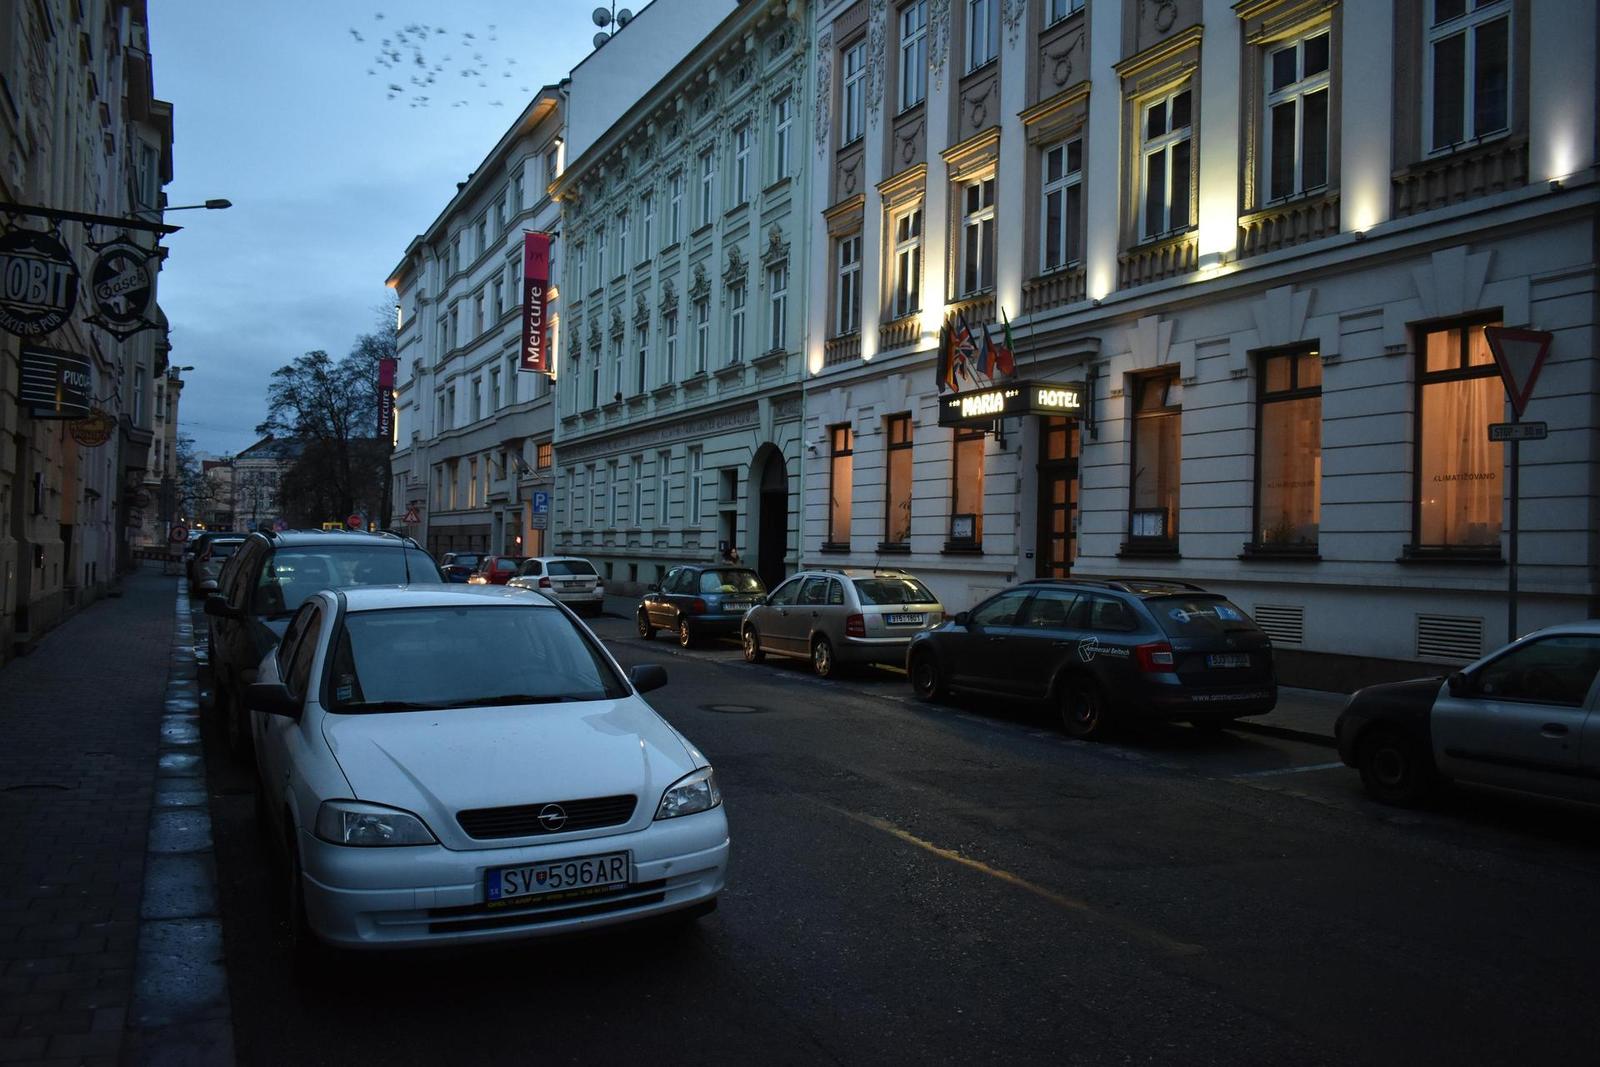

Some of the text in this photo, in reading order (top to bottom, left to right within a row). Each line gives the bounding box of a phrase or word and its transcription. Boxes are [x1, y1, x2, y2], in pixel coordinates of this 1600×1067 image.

[39, 312, 61, 332] PUB
[527, 285, 542, 364] Mercure
[380, 389, 390, 436] Mercure
[962, 390, 1080, 417] MARIA HOTEL
[535, 494, 546, 507] P
[504, 868, 534, 895] SV
[548, 857, 623, 888] 596AR
